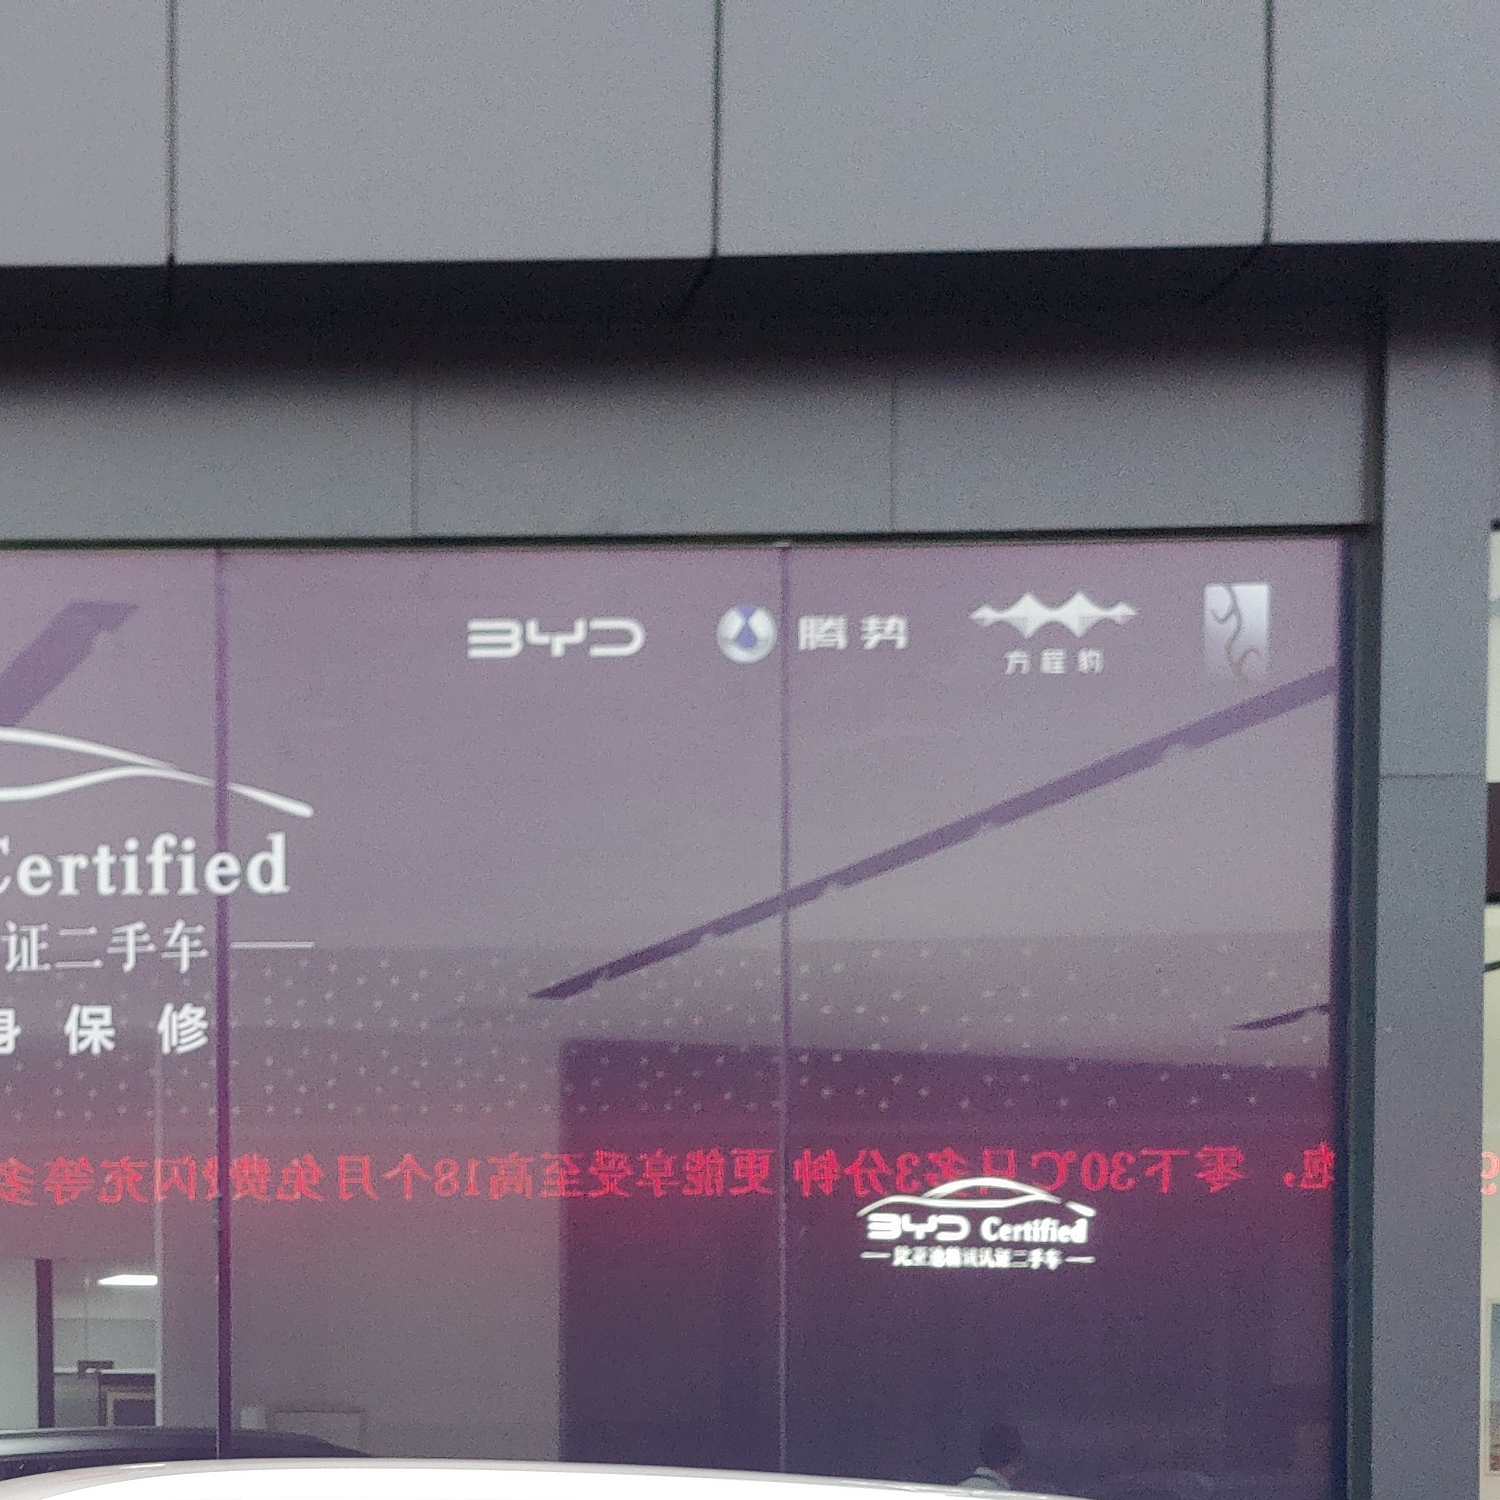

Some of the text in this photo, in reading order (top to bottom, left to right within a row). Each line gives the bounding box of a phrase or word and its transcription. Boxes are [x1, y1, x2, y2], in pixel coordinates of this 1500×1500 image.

[467, 617, 646, 659] BYD
[798, 615, 910, 650] 腾势
[1003, 648, 1104, 676] 方程豹
[867, 1212, 1089, 1244] BYD Certified
